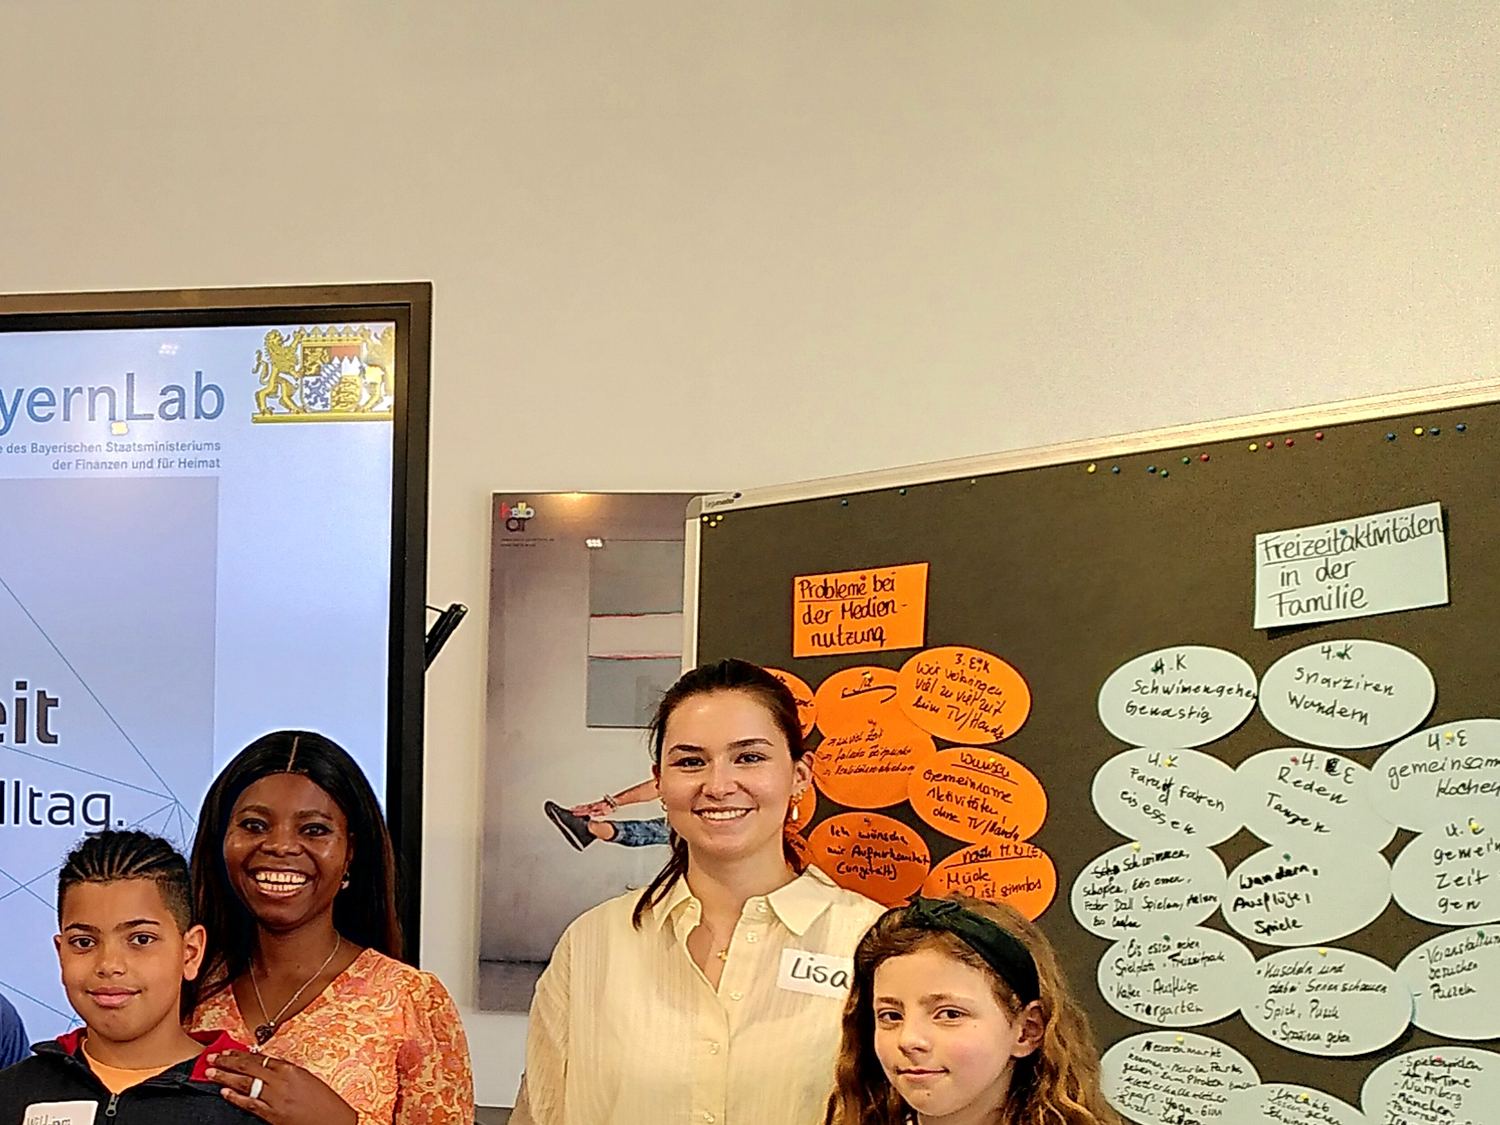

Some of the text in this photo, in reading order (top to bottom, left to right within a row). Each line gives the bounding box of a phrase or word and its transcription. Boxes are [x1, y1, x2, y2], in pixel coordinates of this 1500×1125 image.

[6, 443, 27, 454] des
[31, 441, 102, 456] Bayerischen
[105, 440, 221, 453] Staatsministeriums
[52, 457, 221, 470] der Finanzen und für Heimat
[798, 572, 896, 599] Probleme bei
[1280, 558, 1357, 587] in der
[1268, 583, 1369, 618] Familie
[802, 604, 833, 625] der
[811, 623, 887, 648] nutzung
[1277, 766, 1349, 805] Reden
[790, 957, 849, 990] Lisa
